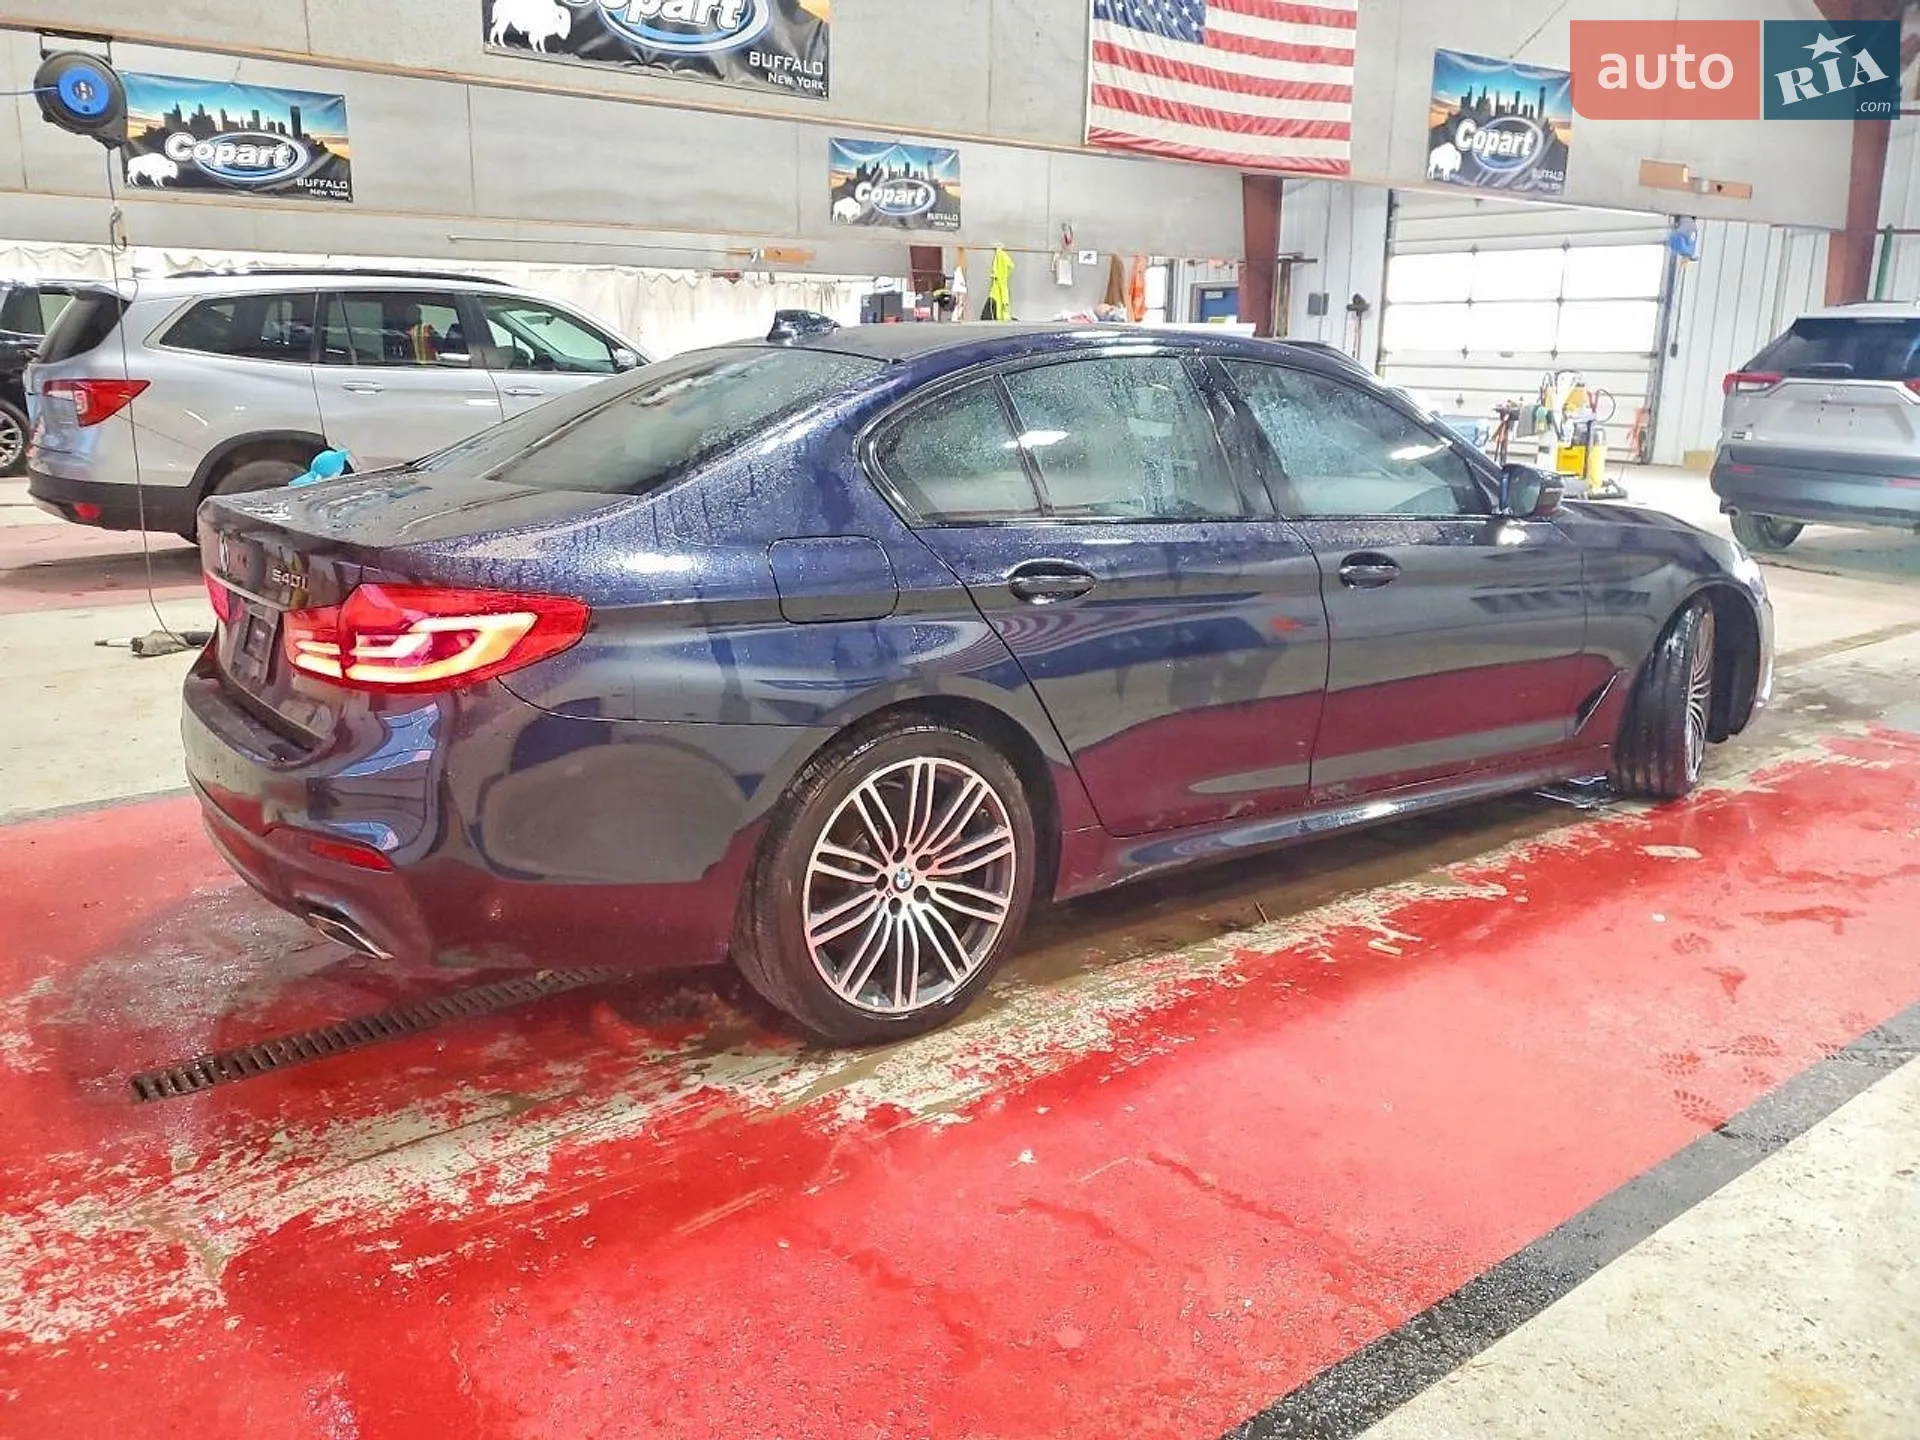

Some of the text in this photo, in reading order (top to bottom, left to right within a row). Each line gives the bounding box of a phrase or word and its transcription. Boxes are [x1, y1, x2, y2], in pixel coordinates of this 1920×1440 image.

[749, 50, 824, 76] BUFFALO
[165, 132, 292, 168] Copart
[1455, 118, 1535, 160] Copart
[296, 177, 348, 189] BUFFALO
[855, 181, 927, 206] Copart
